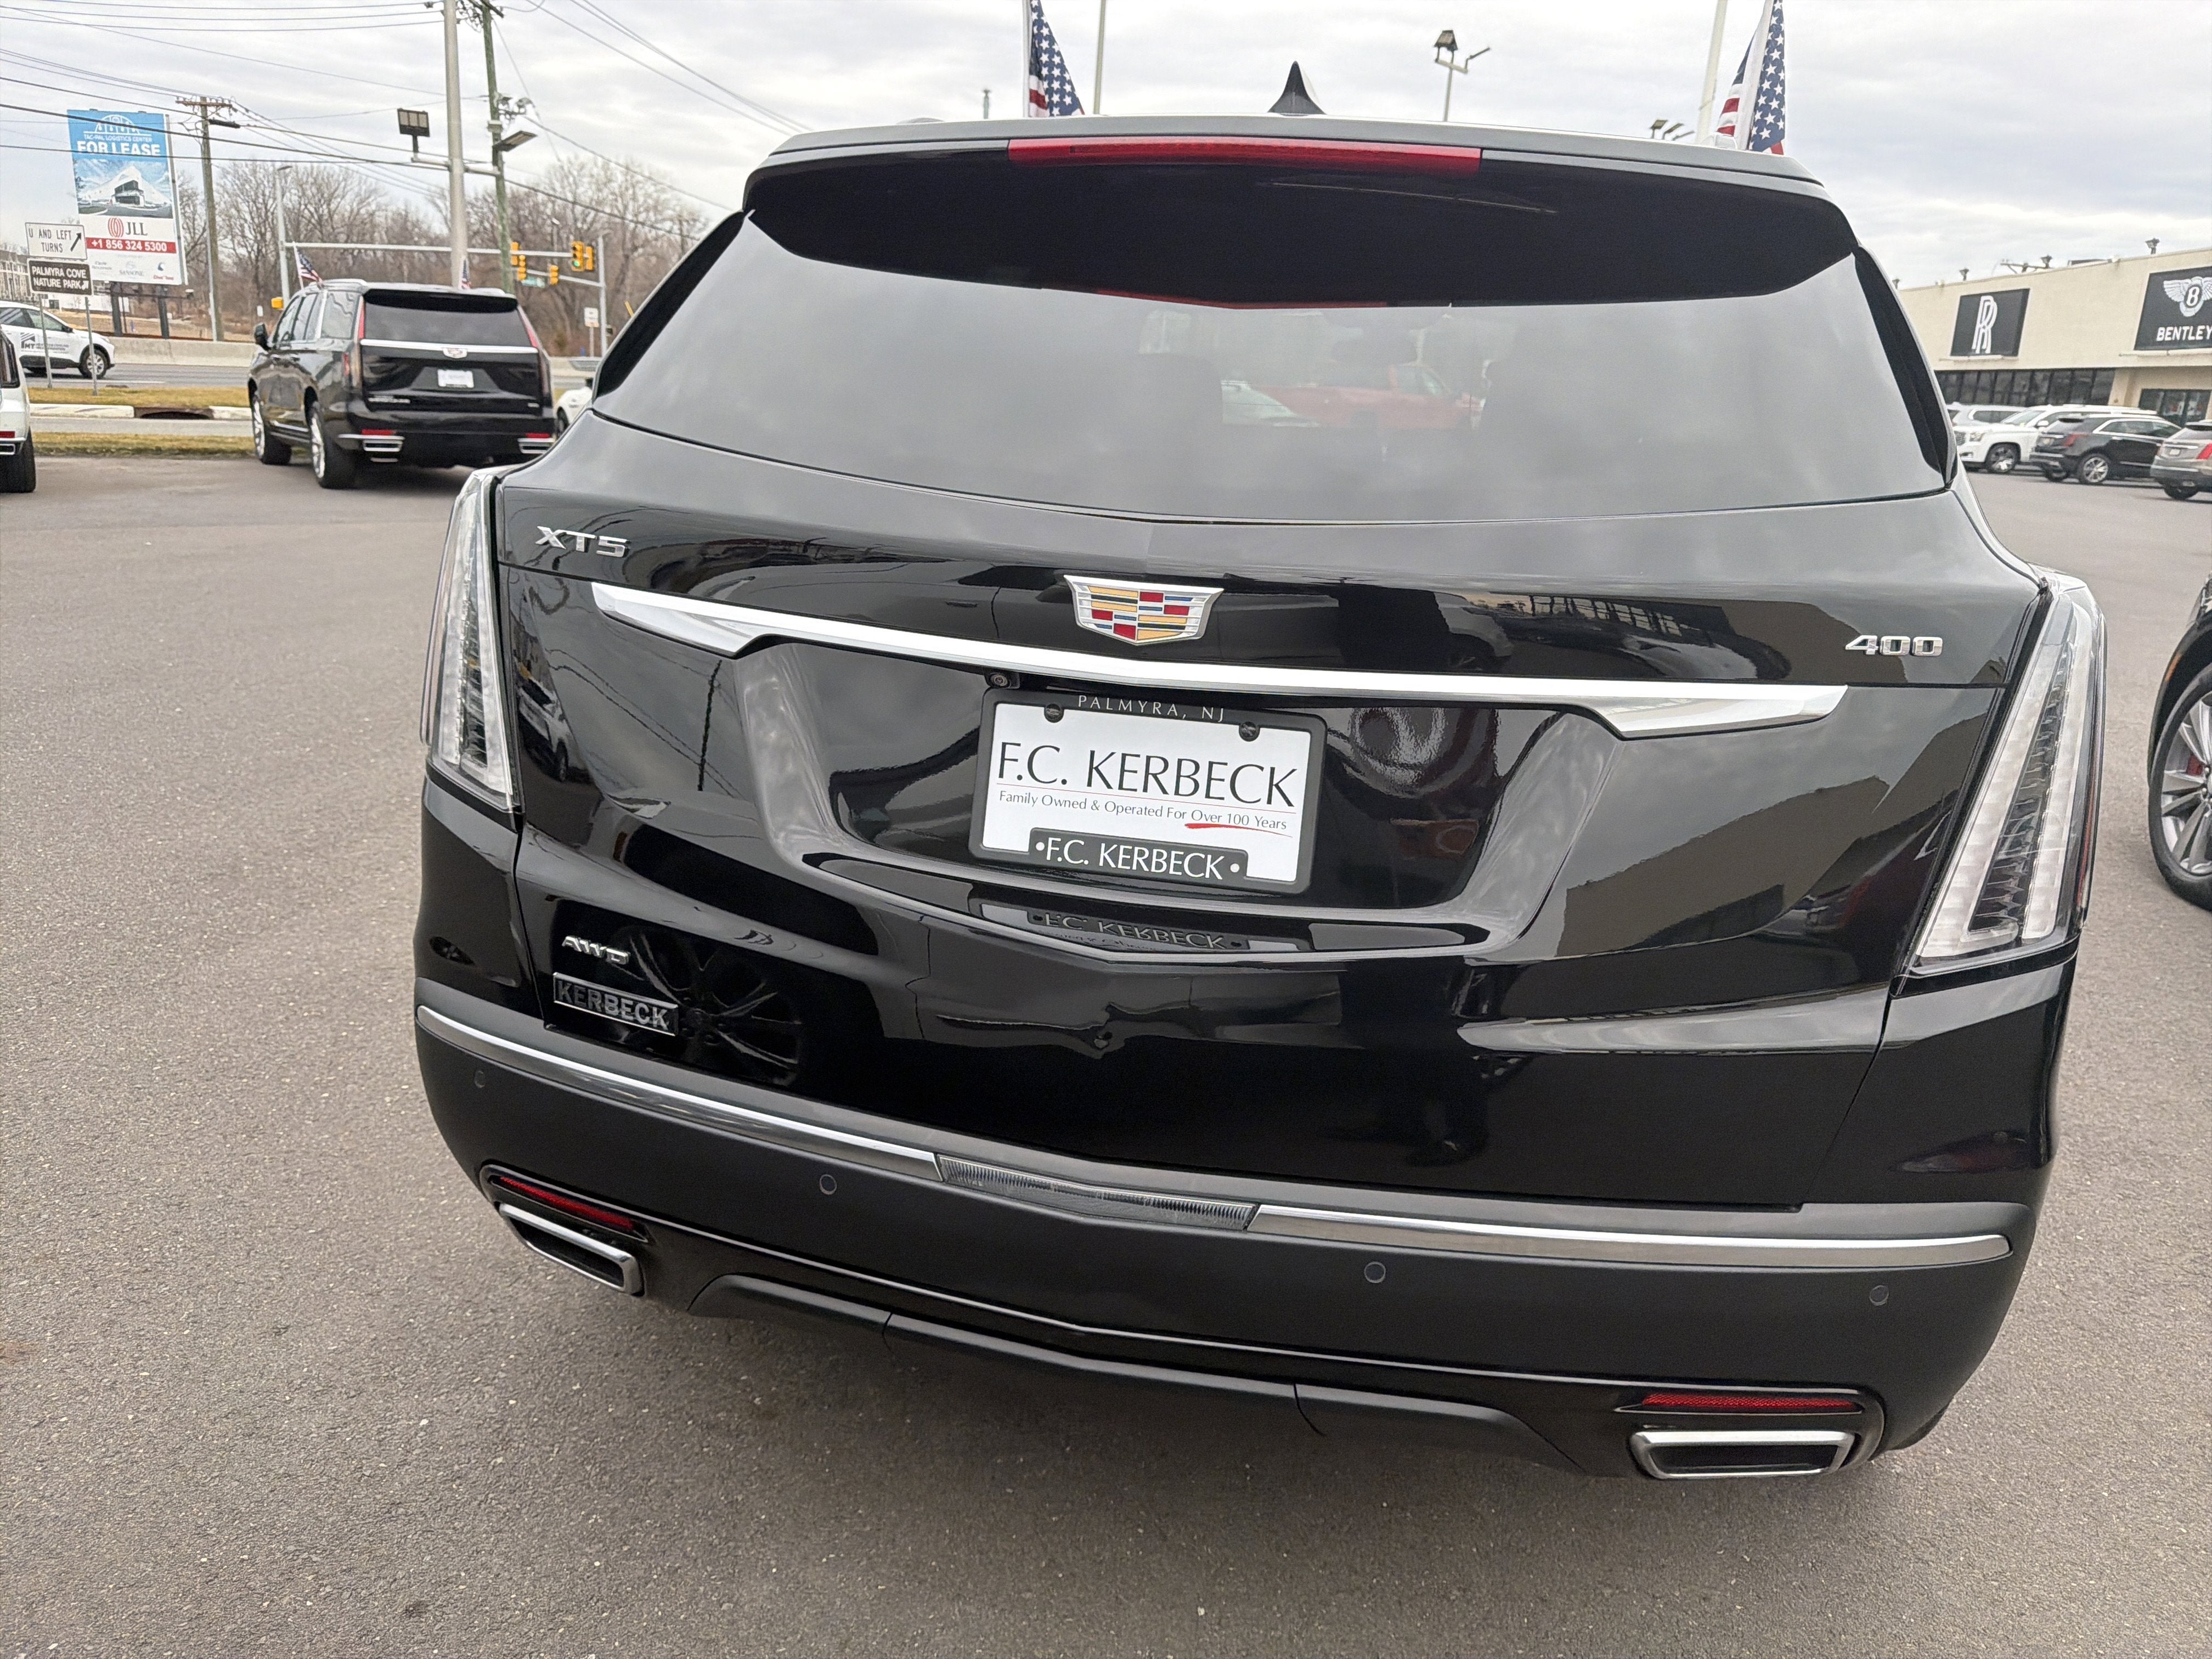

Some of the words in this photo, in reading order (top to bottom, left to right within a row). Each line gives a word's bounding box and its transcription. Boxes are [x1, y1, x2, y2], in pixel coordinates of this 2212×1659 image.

[77, 140, 108, 153] FOR
[111, 142, 161, 156] LEASE
[28, 228, 33, 238] U
[38, 228, 52, 239] AND
[56, 230, 71, 240] LEFT
[126, 222, 148, 236] JLL
[41, 242, 63, 253] TURNS
[91, 239, 103, 249] +1
[105, 240, 123, 250] 856
[125, 241, 143, 251] 324
[144, 241, 167, 252] 5300
[32, 266, 65, 276] PALMYRA
[66, 268, 87, 279] COVE
[33, 277, 61, 288] NATURE
[63, 279, 82, 289] PARK
[2156, 325, 2212, 341] BENTLEY
[535, 526, 629, 558] XT5
[1845, 635, 1943, 656] 400
[1078, 695, 1187, 719] PALMYRA,
[1201, 706, 1224, 723] NJ
[998, 741, 1067, 785] F.C.
[1086, 749, 1298, 808] KERBECK
[1000, 790, 1039, 807] Family
[1042, 794, 1087, 810] Owned
[1091, 800, 1101, 811] &
[1104, 800, 1164, 817] Operated
[1167, 807, 1187, 820] For
[1191, 809, 1223, 823] Over
[1227, 813, 1250, 826] 100
[1254, 815, 1287, 830] Years
[1046, 837, 1090, 865] F.C.
[1099, 843, 1225, 880] KERBECK
[561, 935, 631, 965] AWD
[557, 980, 669, 1031] KERBECK
